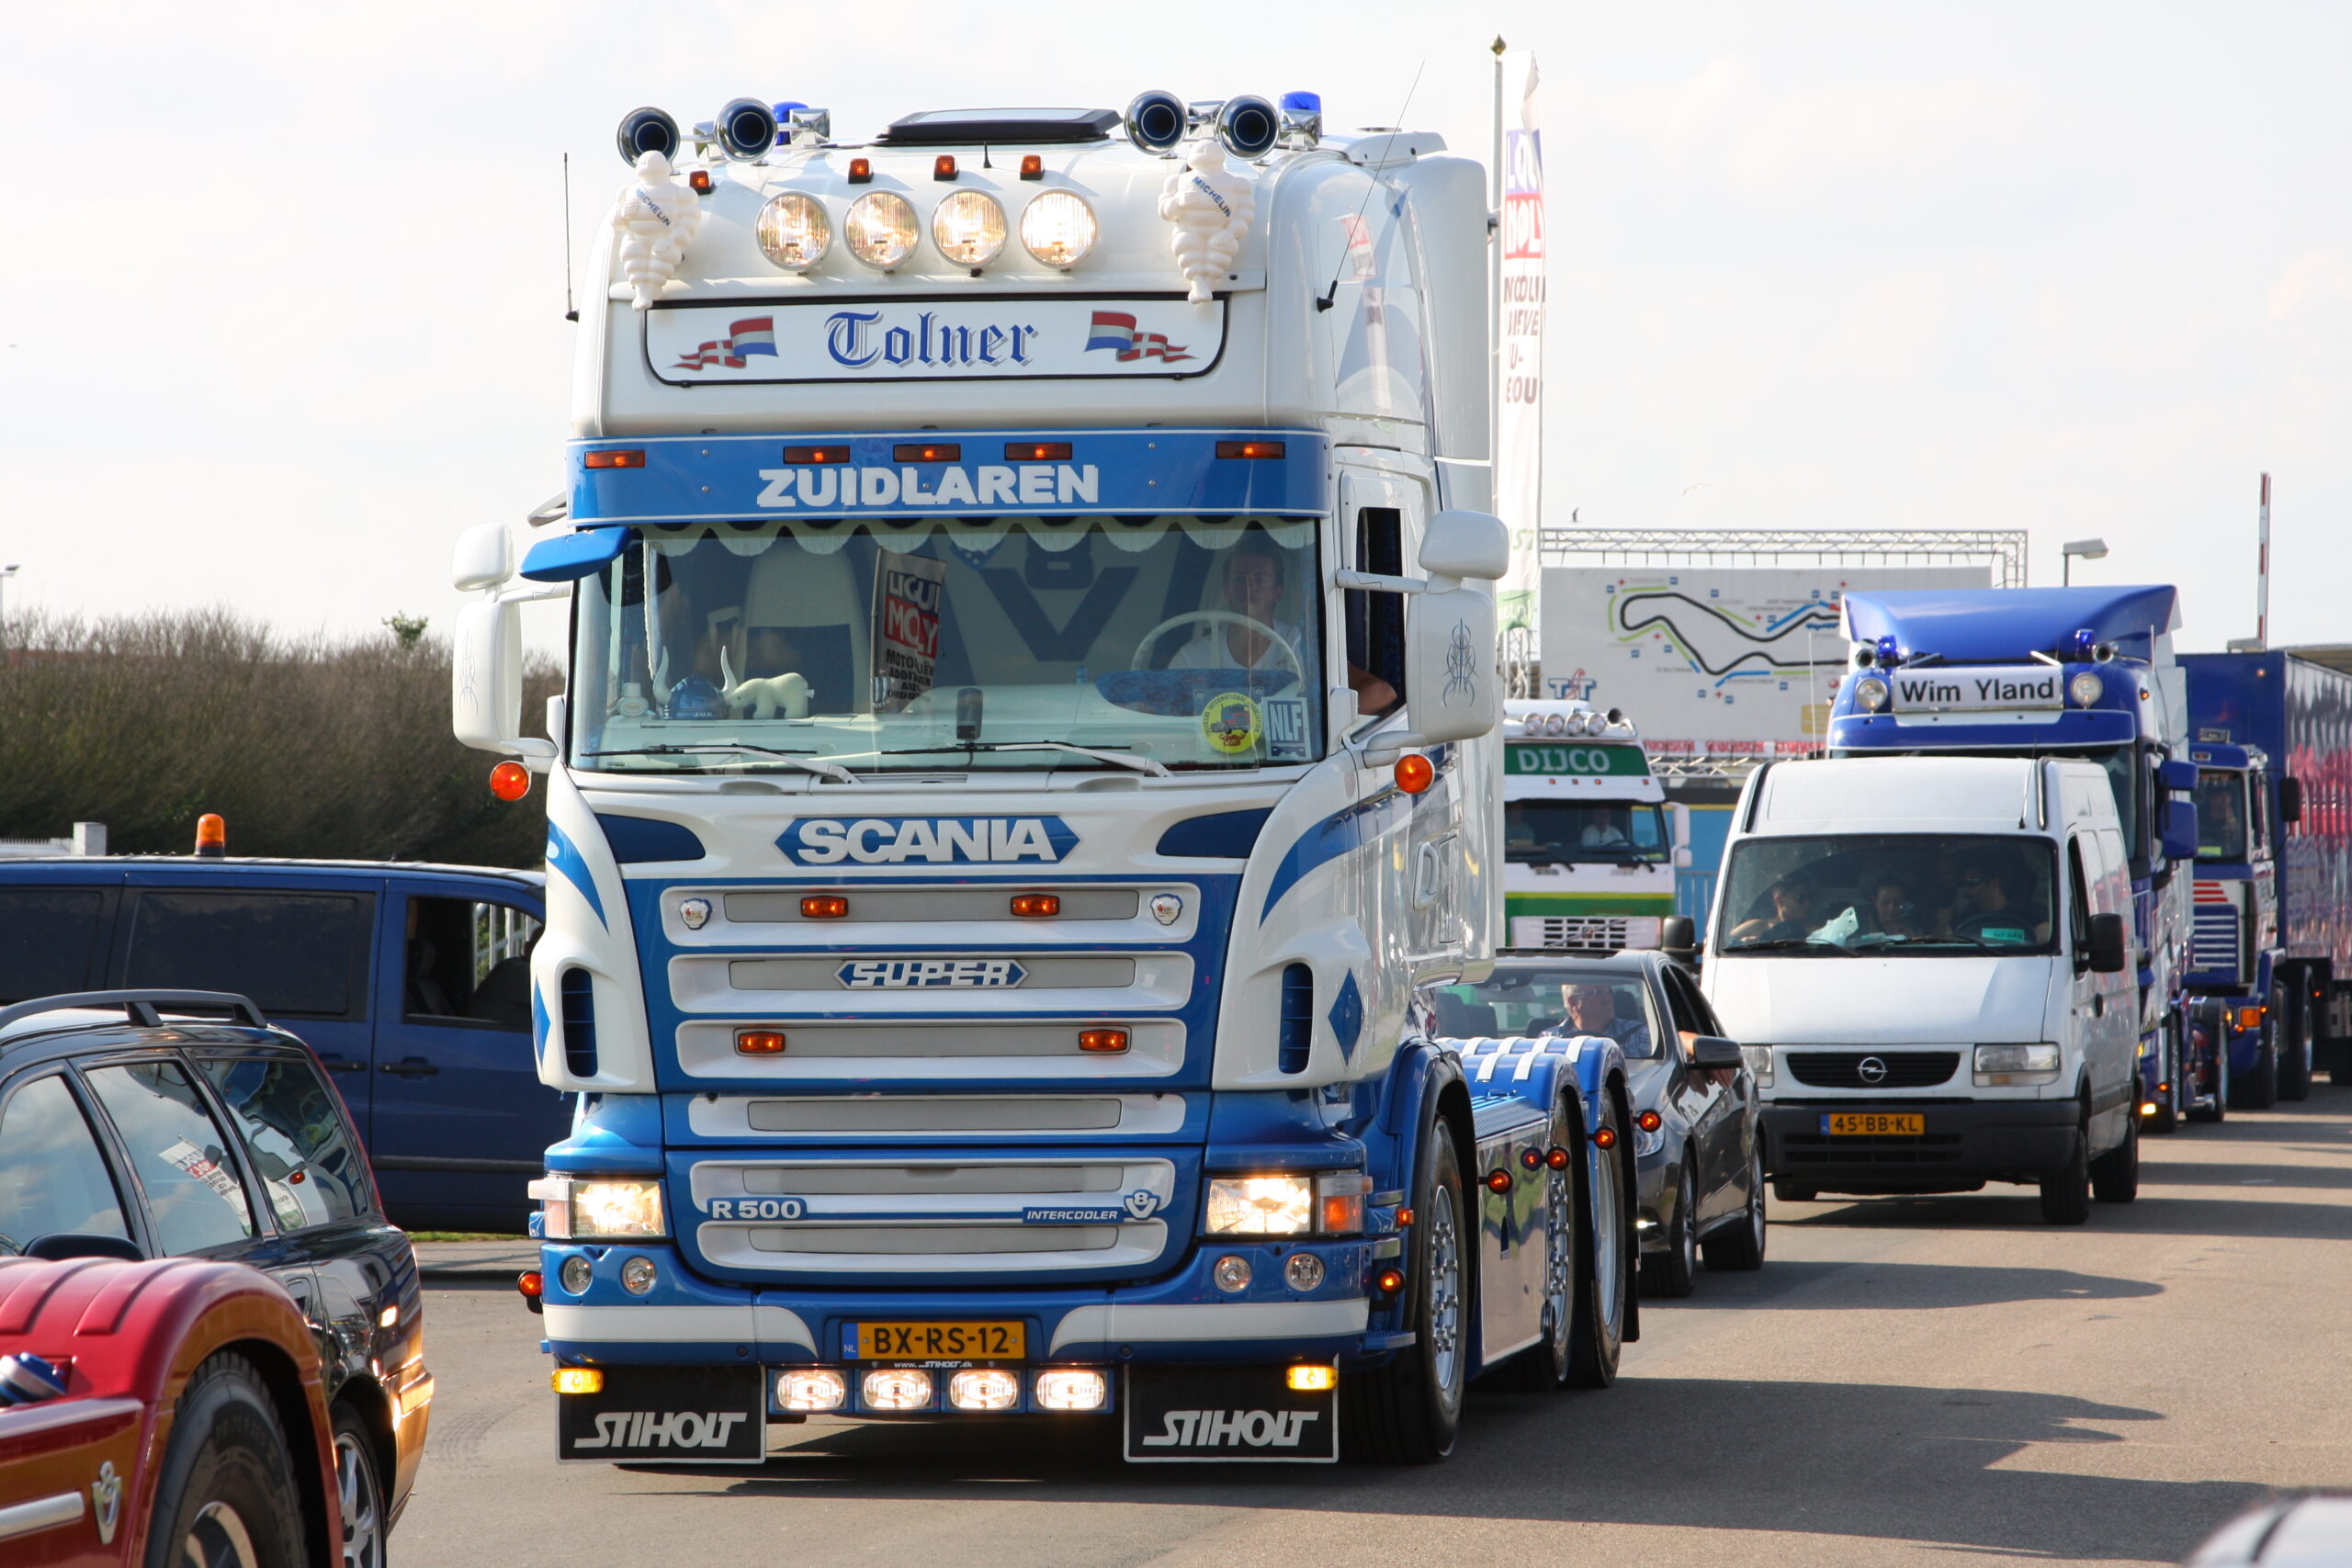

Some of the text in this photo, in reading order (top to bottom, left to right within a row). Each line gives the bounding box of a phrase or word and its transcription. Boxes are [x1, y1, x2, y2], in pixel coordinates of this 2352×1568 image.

[636, 187, 672, 226] MICHELIN
[1193, 175, 1232, 218] MICHELIN
[824, 310, 1039, 369] Tolner
[756, 465, 1099, 507] ZUIDLAREN
[887, 599, 939, 656] MOLY
[1900, 676, 2054, 703] Wim Yland
[1269, 704, 1302, 741] NLF
[1517, 749, 1611, 773] DIJCO
[797, 819, 1057, 863] SCANIA
[850, 962, 1011, 987] SUPER
[1835, 1116, 1918, 1133] 45-BB-KL
[712, 1200, 801, 1219] R 500
[1027, 1210, 1118, 1220] INTERCOOLER
[843, 1326, 1010, 1354] NL BX-RS-12
[573, 1411, 748, 1449] STIHOLT
[1142, 1410, 1319, 1447] STIHOLT
